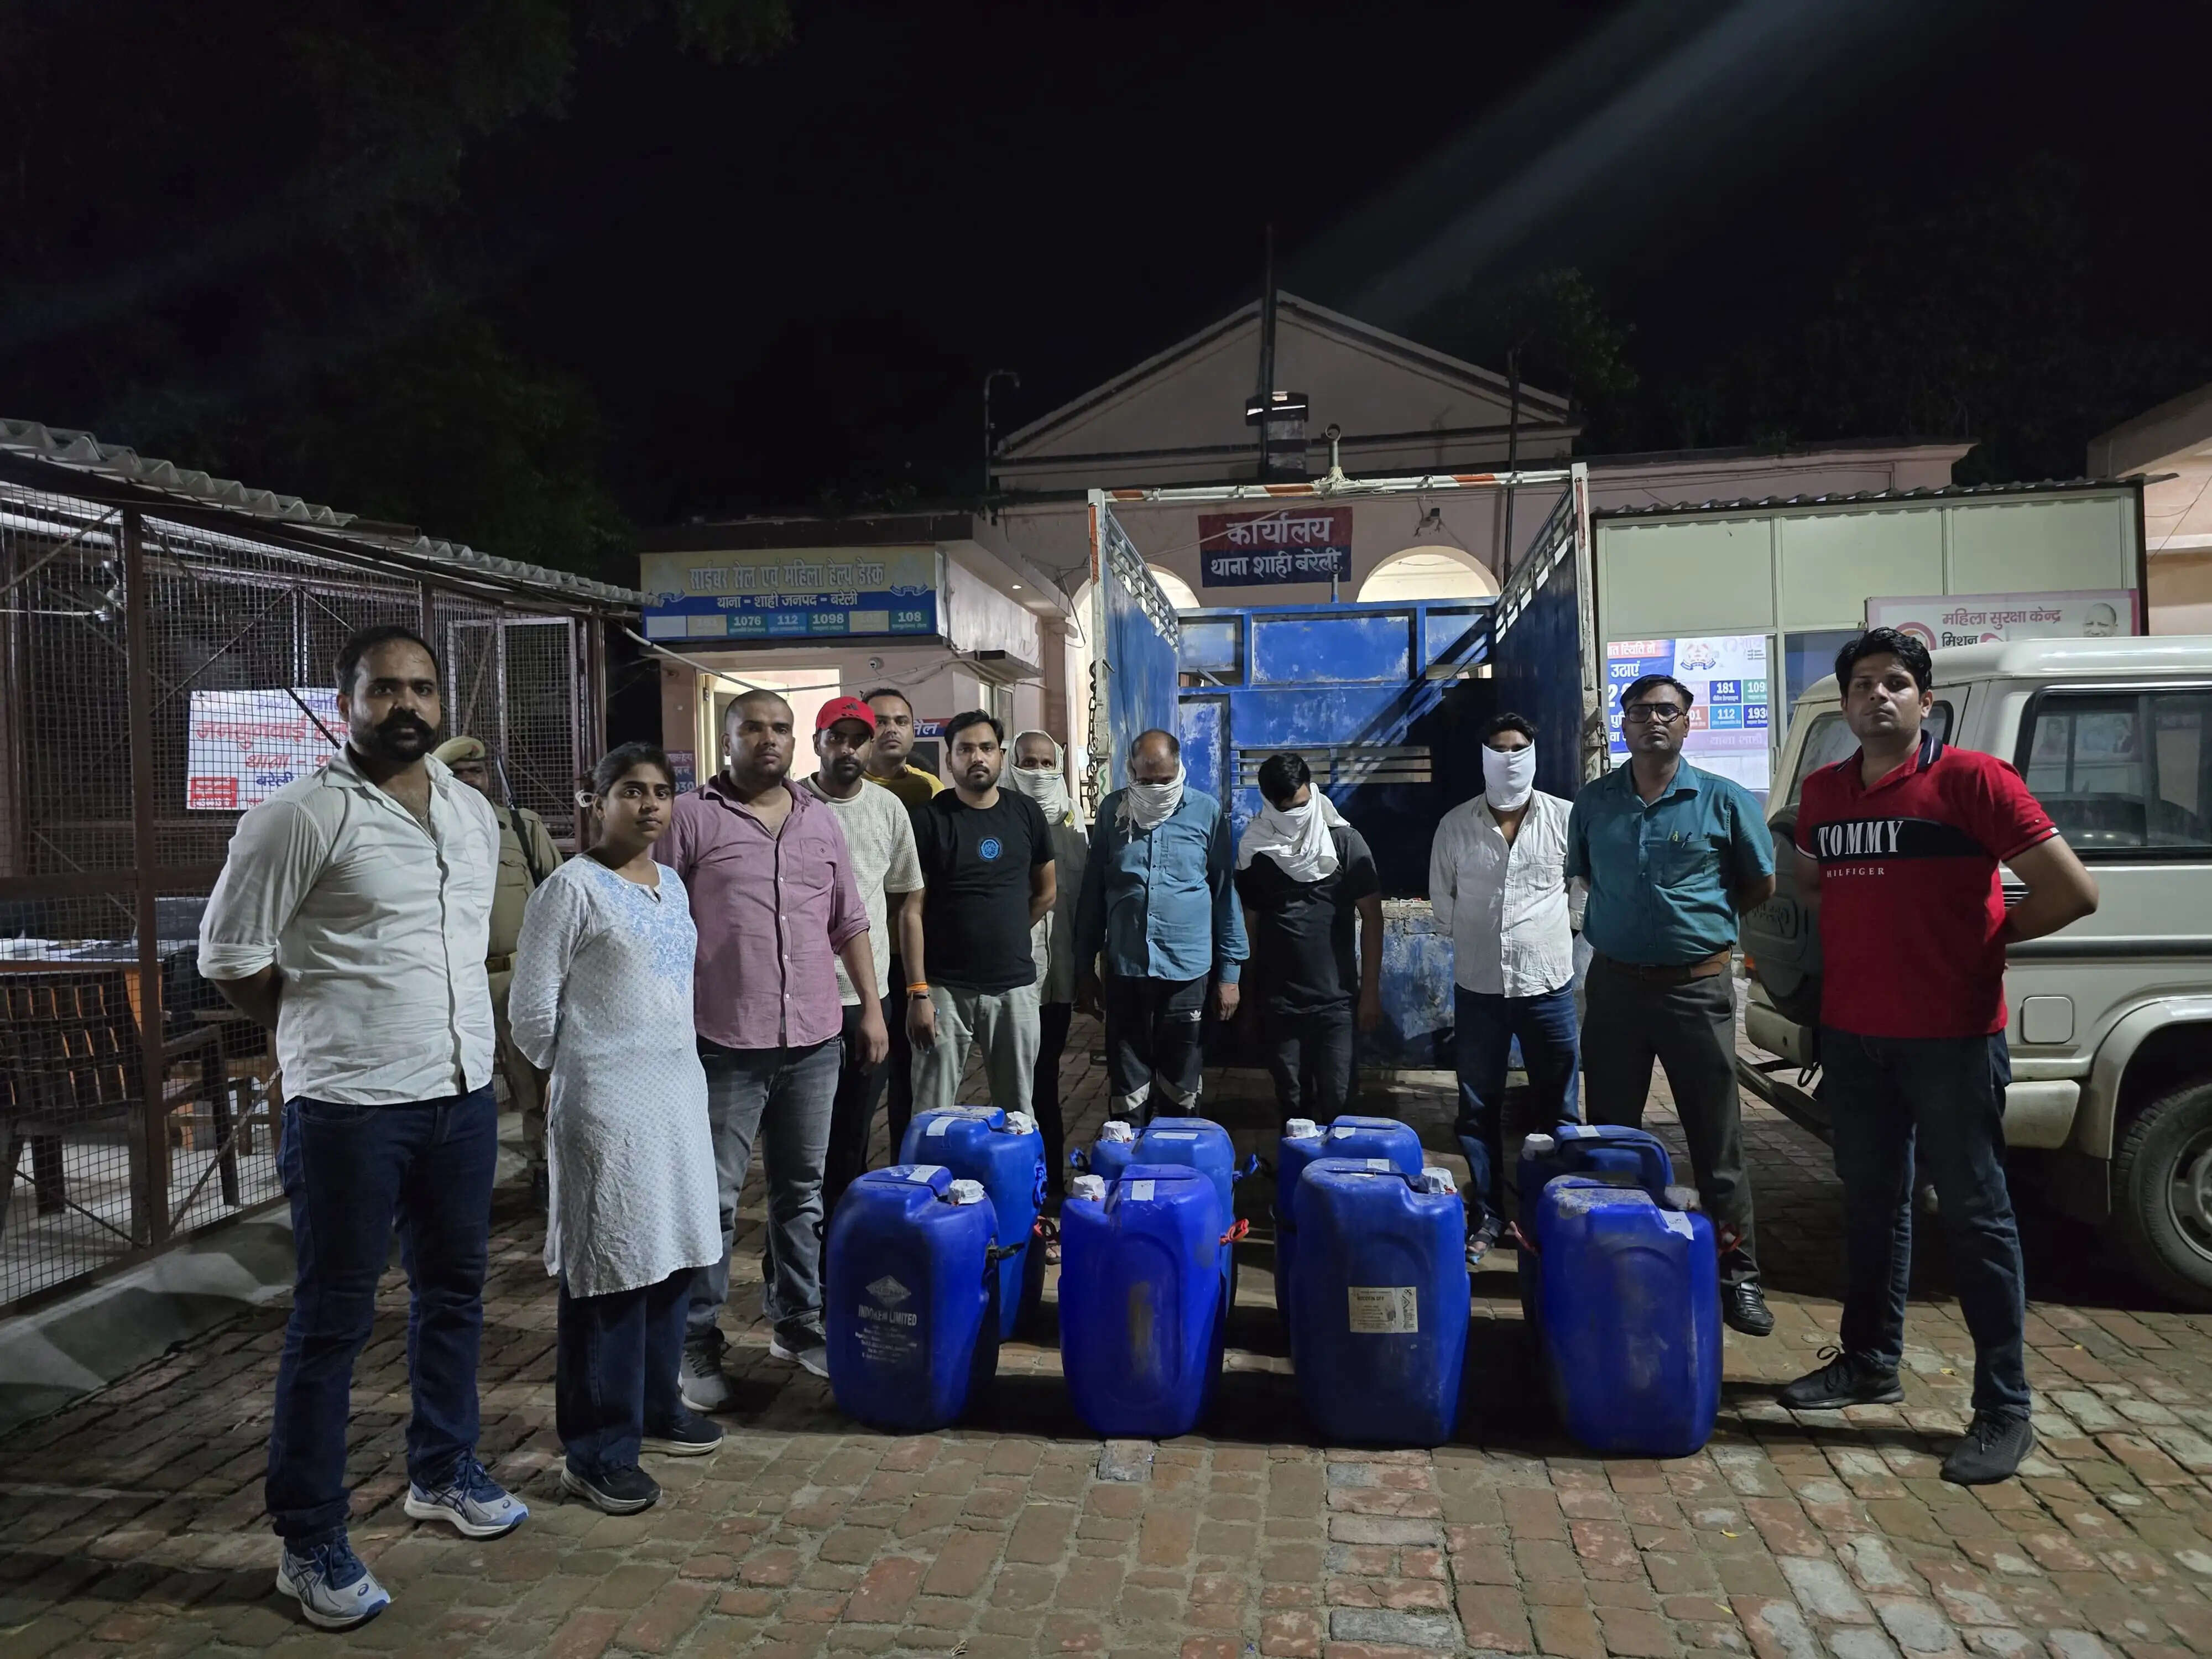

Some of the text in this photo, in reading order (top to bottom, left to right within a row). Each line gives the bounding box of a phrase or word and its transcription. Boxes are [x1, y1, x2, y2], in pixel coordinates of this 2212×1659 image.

[1226, 513, 1334, 545] कार्यालय
[1211, 547, 1342, 578] थाना शाही बरेली
[733, 560, 757, 588] सेल
[760, 557, 779, 588] एवं
[783, 559, 824, 587] महिला
[828, 557, 854, 586] हेल्प
[857, 557, 885, 586] डेस्क
[717, 596, 741, 608] थाना
[754, 589, 779, 608] शाही
[781, 594, 818, 607] जनपद
[830, 588, 858, 606] बरेली
[733, 615, 761, 627] 1076
[777, 614, 799, 625] 112
[812, 613, 845, 625] 1098
[898, 612, 922, 622] 108
[1942, 606, 2062, 630] महिला सुरक्षा केन्द्र
[1942, 632, 1979, 646] मिशन
[1610, 660, 1641, 677] उठाएं
[1717, 682, 1735, 693] 181
[1747, 681, 1767, 693] 109
[1689, 709, 1702, 720] 01
[1718, 708, 1735, 719] 112
[255, 771, 294, 786] बरेली
[1818, 821, 1904, 857] TOMMY
[1827, 867, 1885, 878] HILFIGER
[889, 1309, 917, 1326] LIMITED
